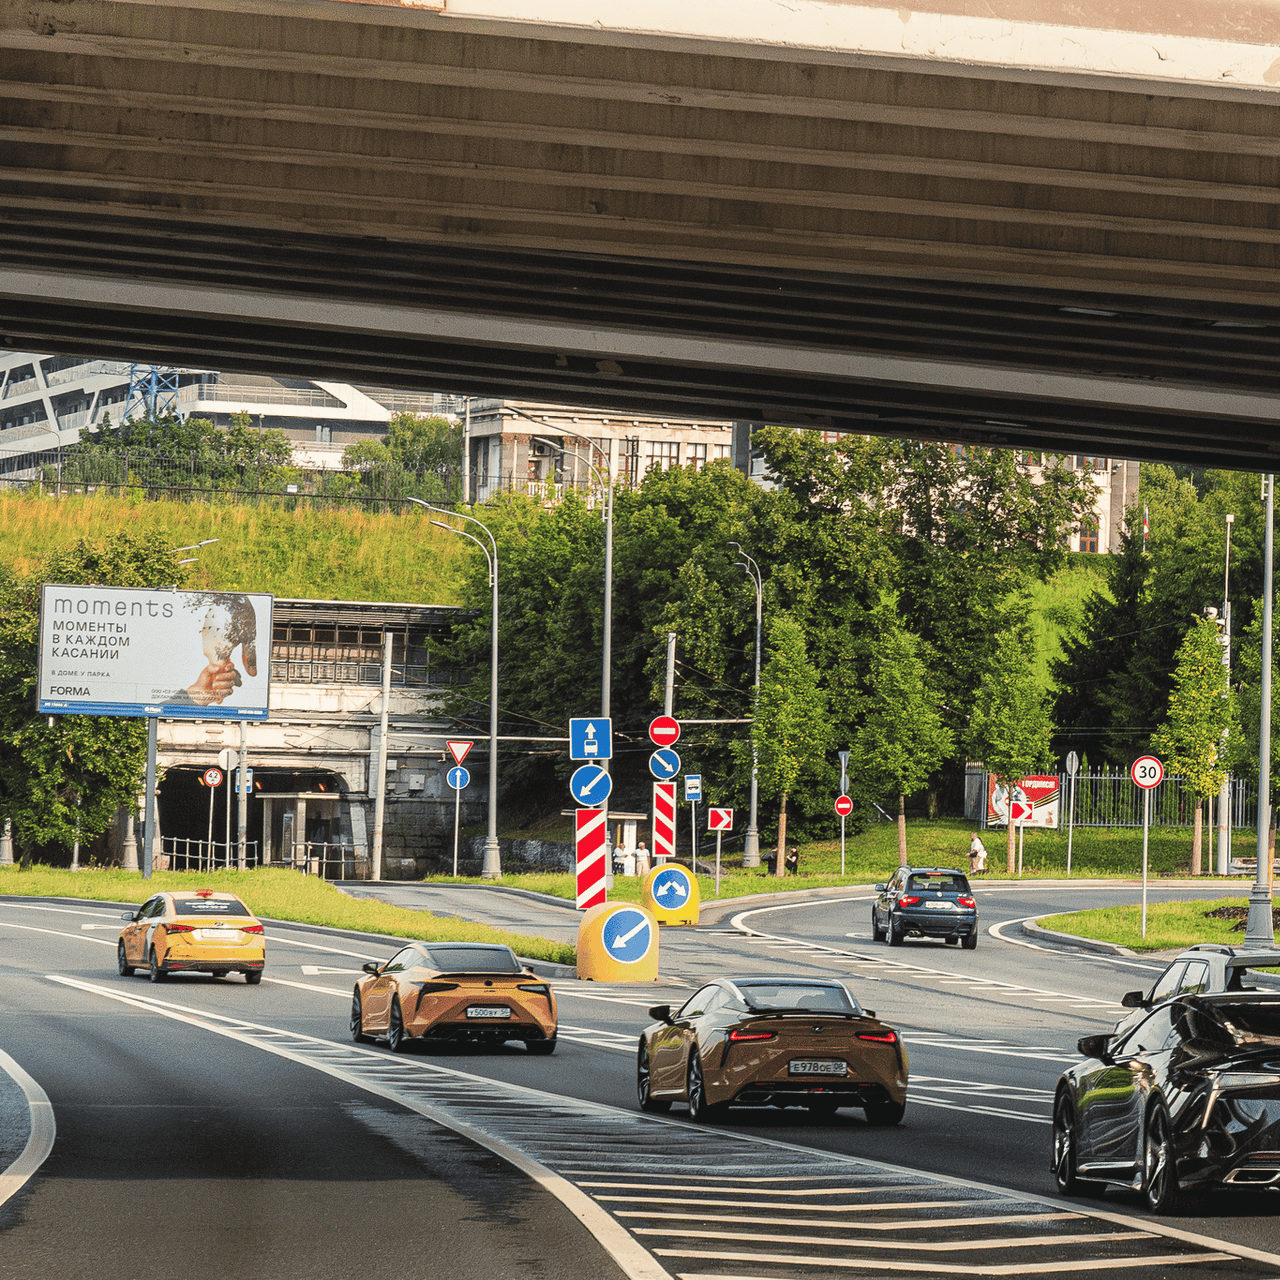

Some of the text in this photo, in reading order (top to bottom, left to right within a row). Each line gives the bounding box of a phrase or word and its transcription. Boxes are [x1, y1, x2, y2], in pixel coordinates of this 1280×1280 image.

[54, 598, 174, 618] moments
[52, 620, 127, 633] МОМЕНТЫ
[52, 634, 130, 648] В КАЖДОМ
[51, 647, 119, 660] КАСАНИИ
[50, 685, 91, 696] FORMA
[1138, 765, 1157, 779] 30
[793, 1062, 831, 1072] Е978ОЕ
